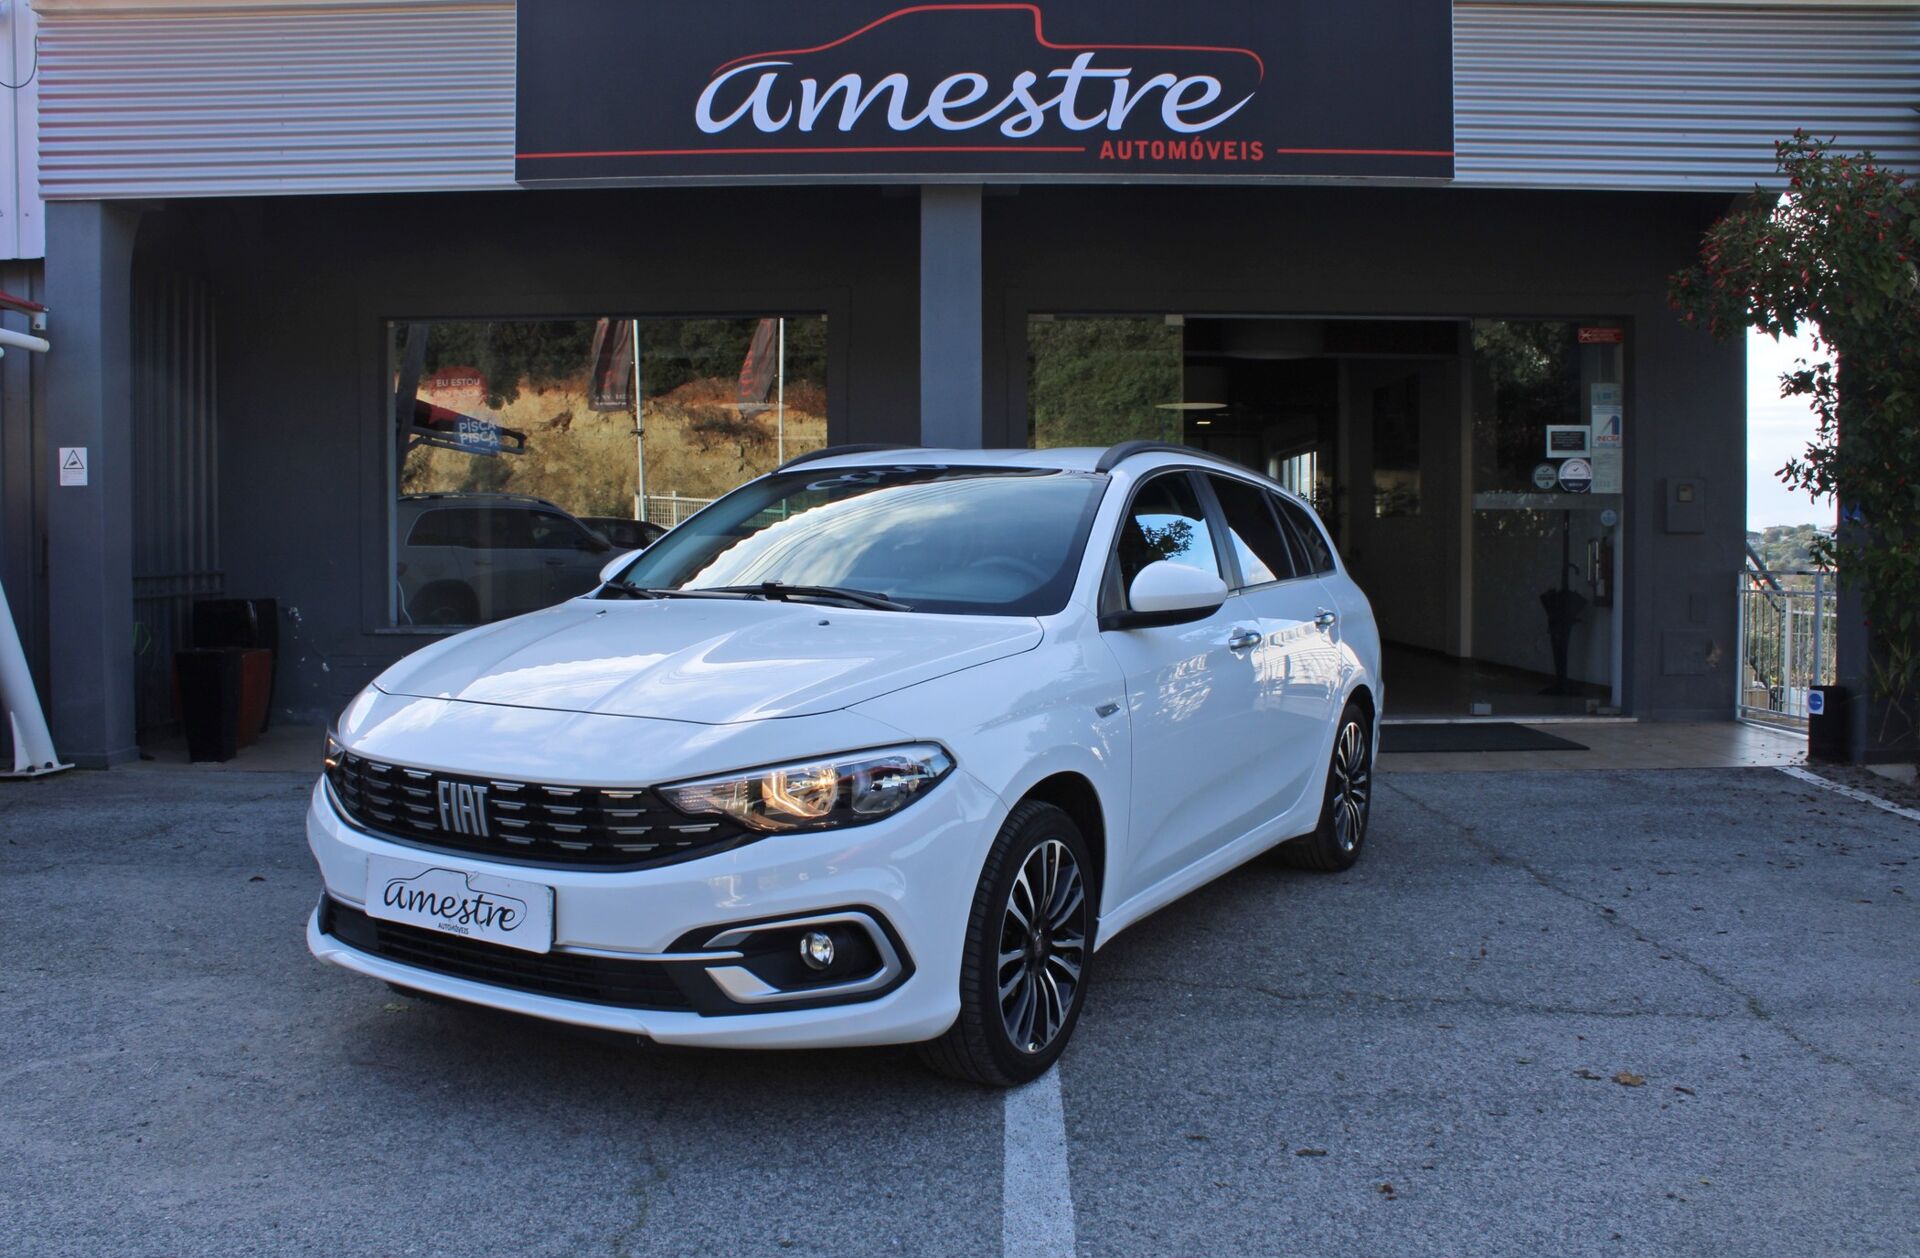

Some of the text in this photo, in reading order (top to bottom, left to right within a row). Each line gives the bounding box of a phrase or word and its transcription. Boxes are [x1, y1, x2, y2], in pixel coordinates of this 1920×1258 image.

[695, 52, 1256, 138] amestre
[1099, 136, 1264, 161] AUTOMÓVEIS
[435, 378, 480, 387] EU ESTOU
[438, 780, 489, 837] FIAT
[384, 881, 517, 931] amestre
